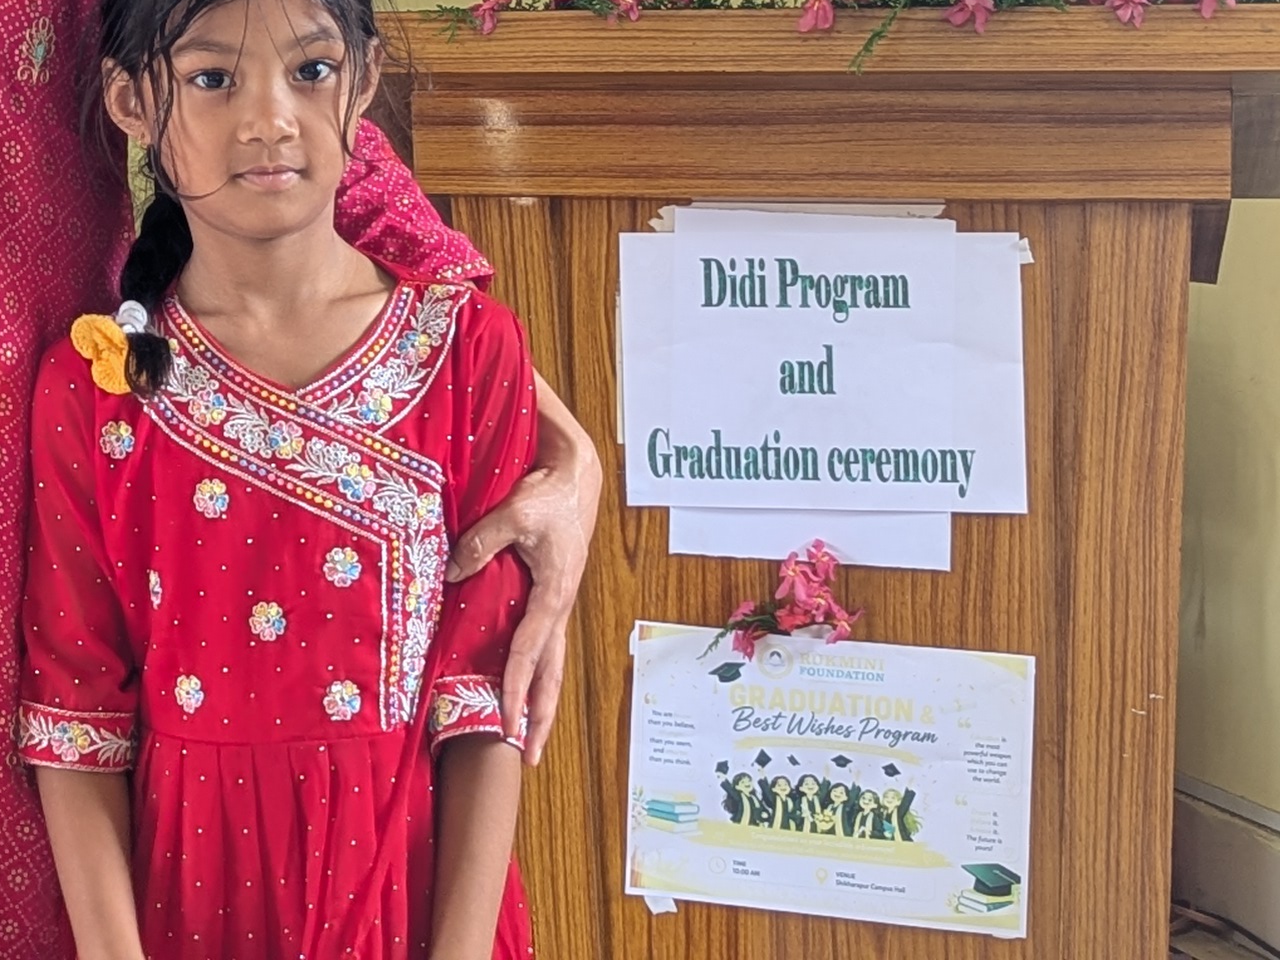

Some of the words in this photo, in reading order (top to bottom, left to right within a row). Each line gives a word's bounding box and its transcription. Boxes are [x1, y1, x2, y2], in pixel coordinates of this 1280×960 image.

[699, 257, 768, 309] Didi
[774, 258, 911, 324] Program
[779, 344, 837, 396] and
[646, 427, 821, 482] Graduation
[826, 447, 977, 499] ceremony
[799, 665, 885, 682] FOUNDATION
[729, 683, 914, 723] GRADUATION
[919, 704, 935, 725] &
[731, 706, 787, 732] Best
[787, 711, 856, 738] Wishes
[857, 717, 939, 748] Program
